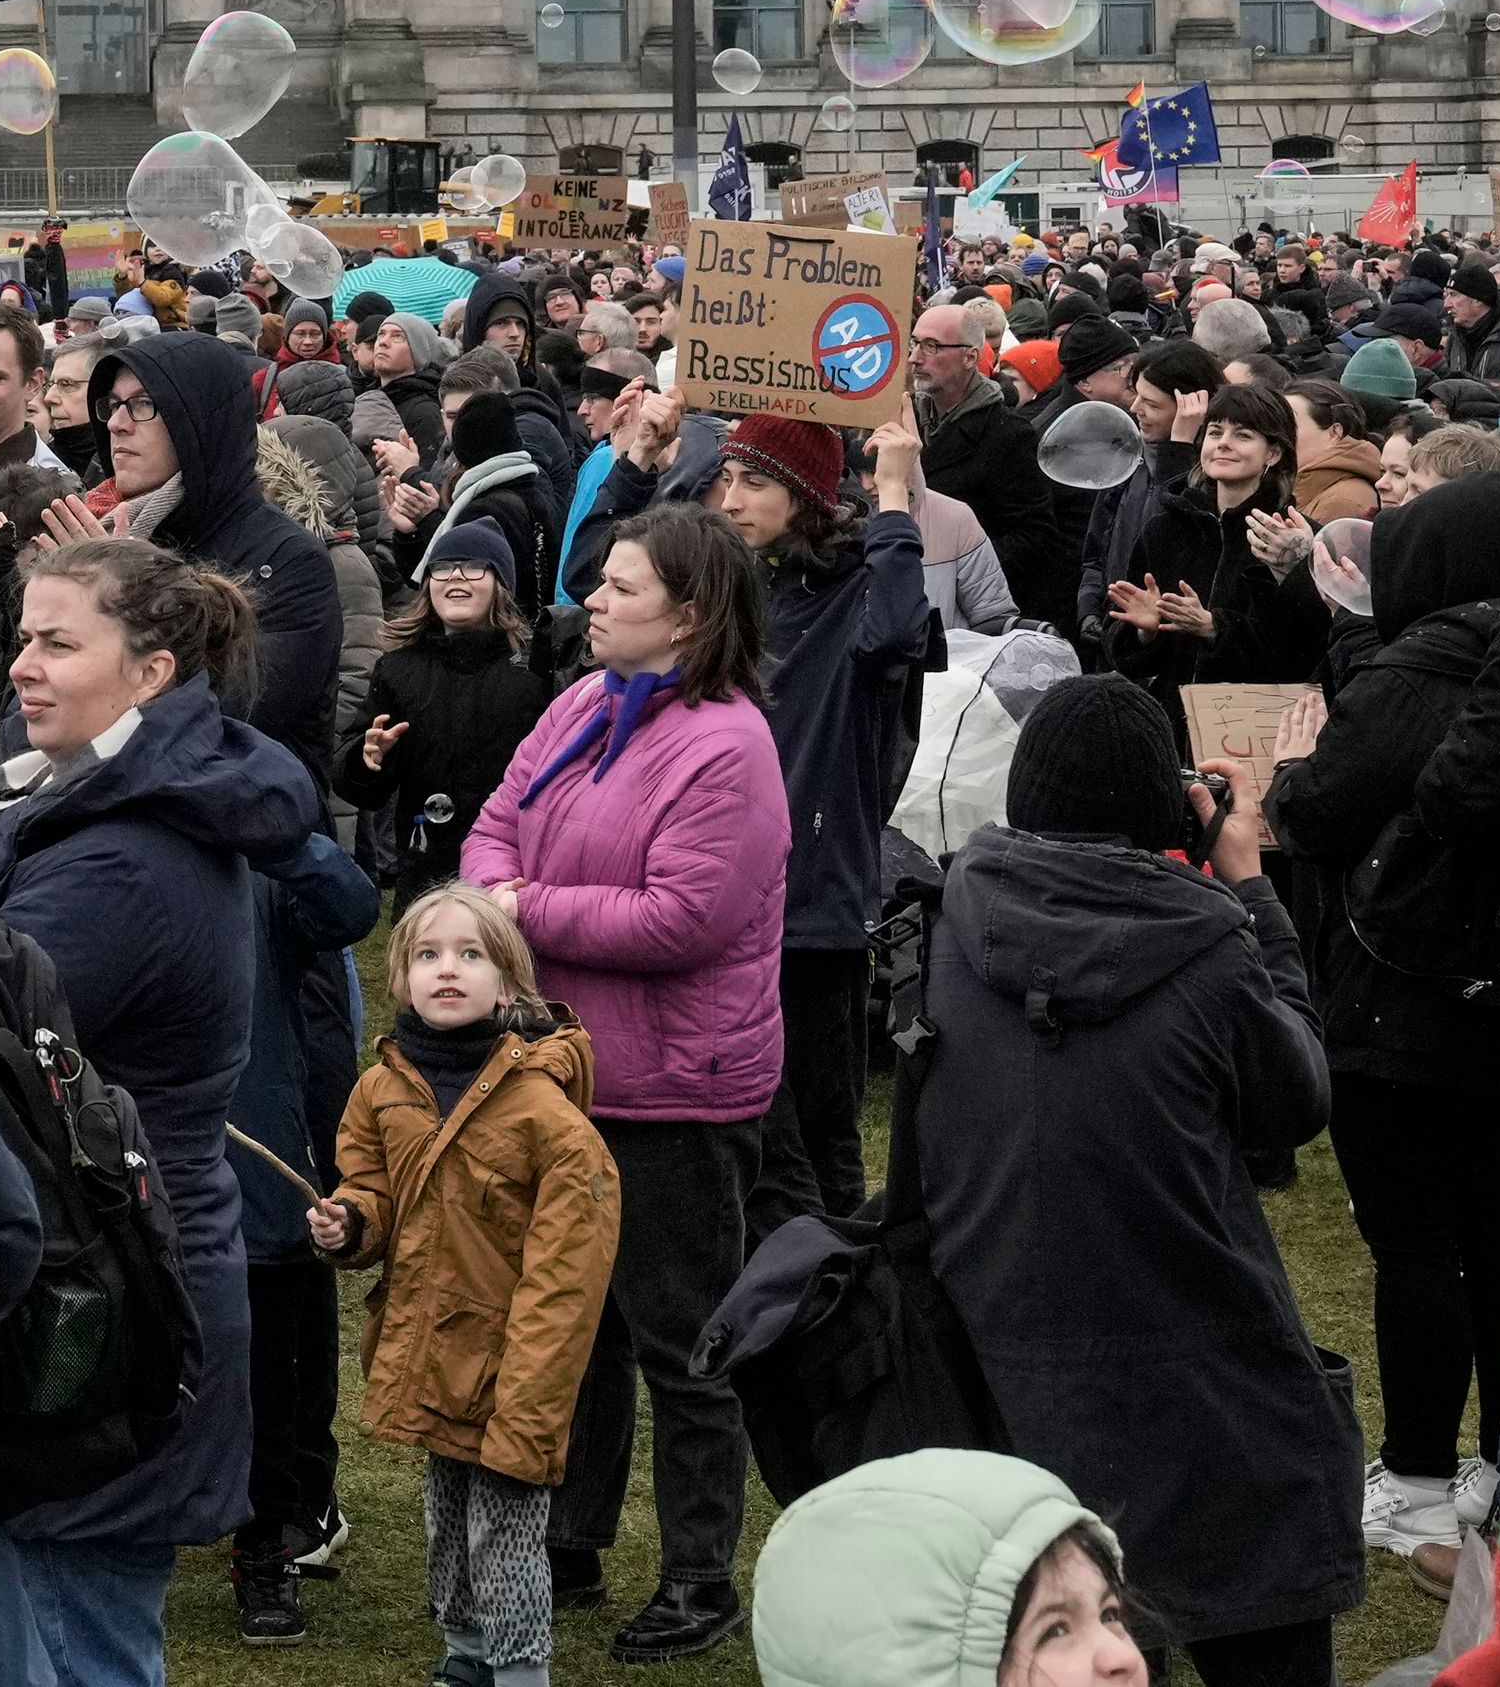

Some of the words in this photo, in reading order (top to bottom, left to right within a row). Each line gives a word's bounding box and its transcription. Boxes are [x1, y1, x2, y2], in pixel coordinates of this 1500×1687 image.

[554, 179, 598, 198] KEINE
[782, 179, 837, 194] POLITISCHE
[558, 210, 585, 224] DER
[517, 218, 626, 241] INTOLERANZ
[695, 230, 755, 275] Das
[764, 232, 882, 287] Problem
[690, 285, 776, 328] heißt:
[687, 339, 851, 394] Rassismus
[283, 1564, 301, 1575] FILA
